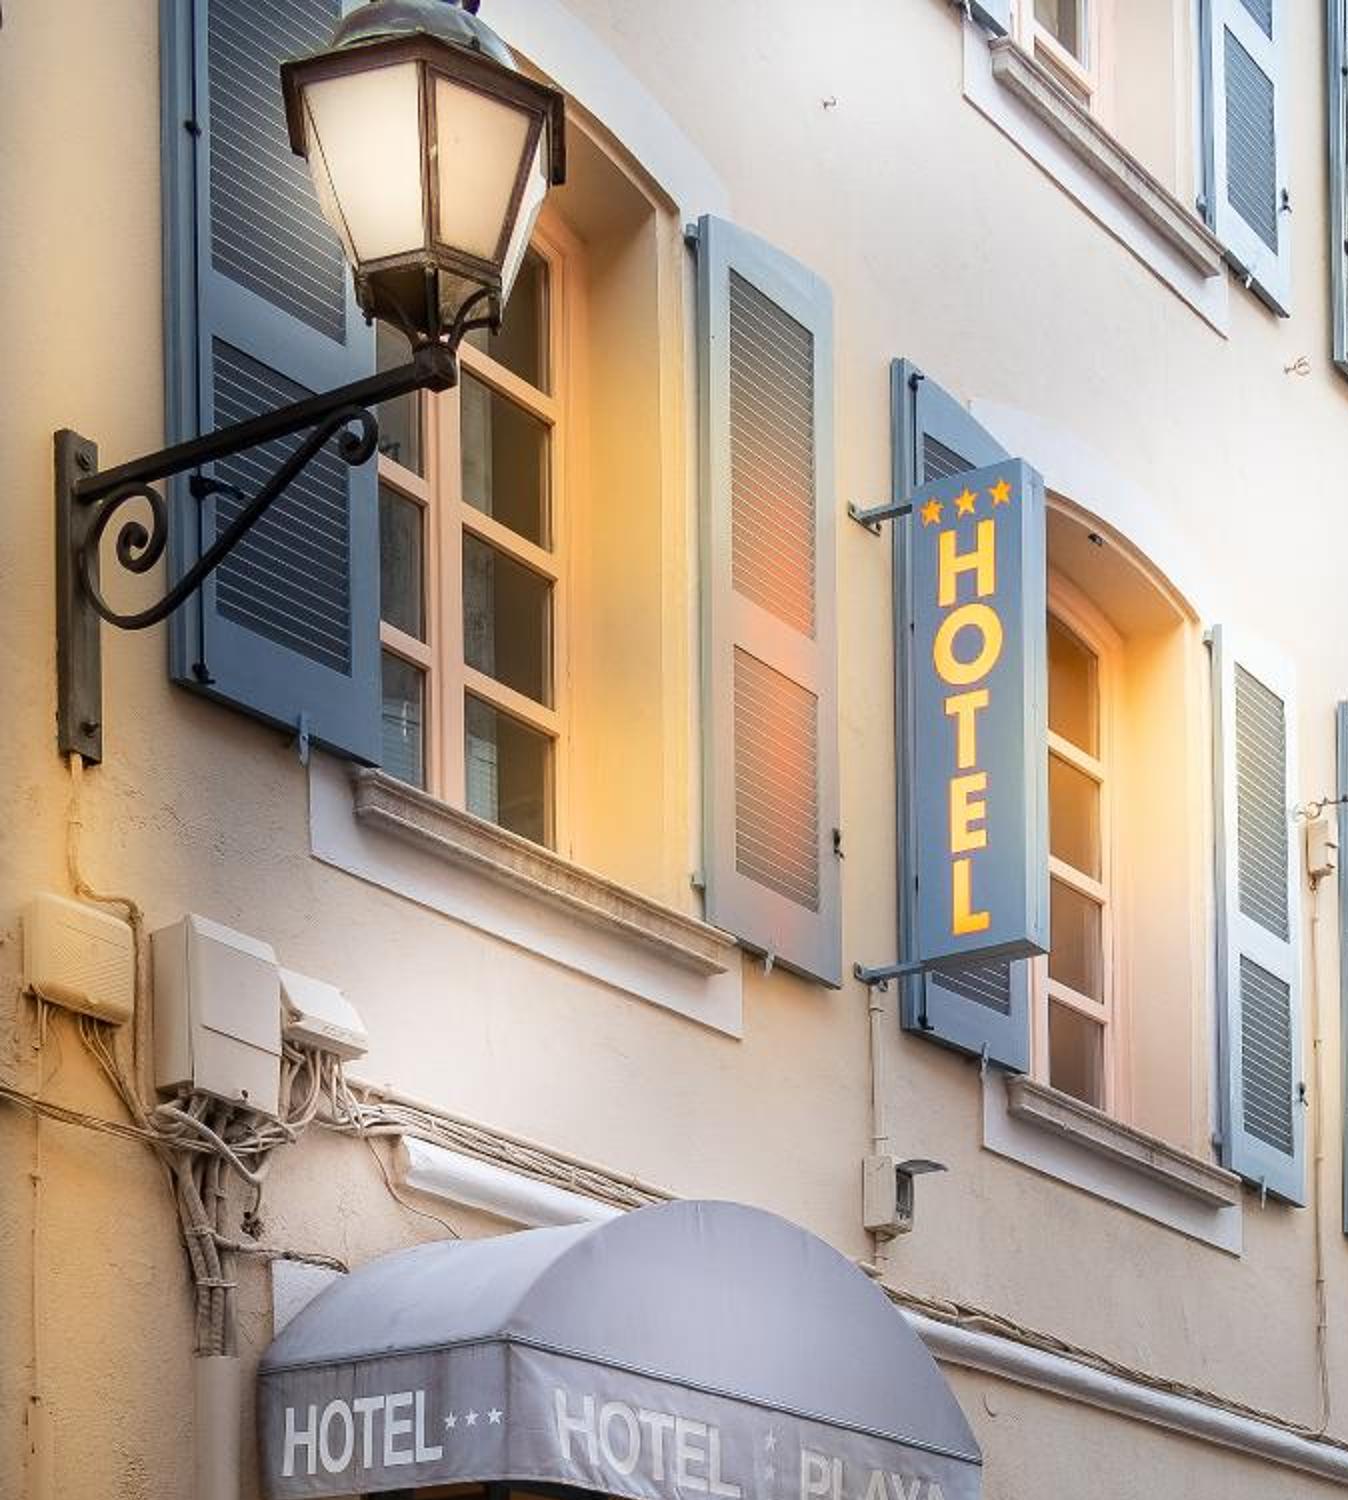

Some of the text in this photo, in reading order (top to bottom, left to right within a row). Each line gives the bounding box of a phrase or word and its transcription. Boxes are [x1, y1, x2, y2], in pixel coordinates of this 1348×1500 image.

[932, 518, 1004, 936] HOTEL
[281, 1389, 443, 1478] HOTEL
[553, 1387, 742, 1499] HOTEL
